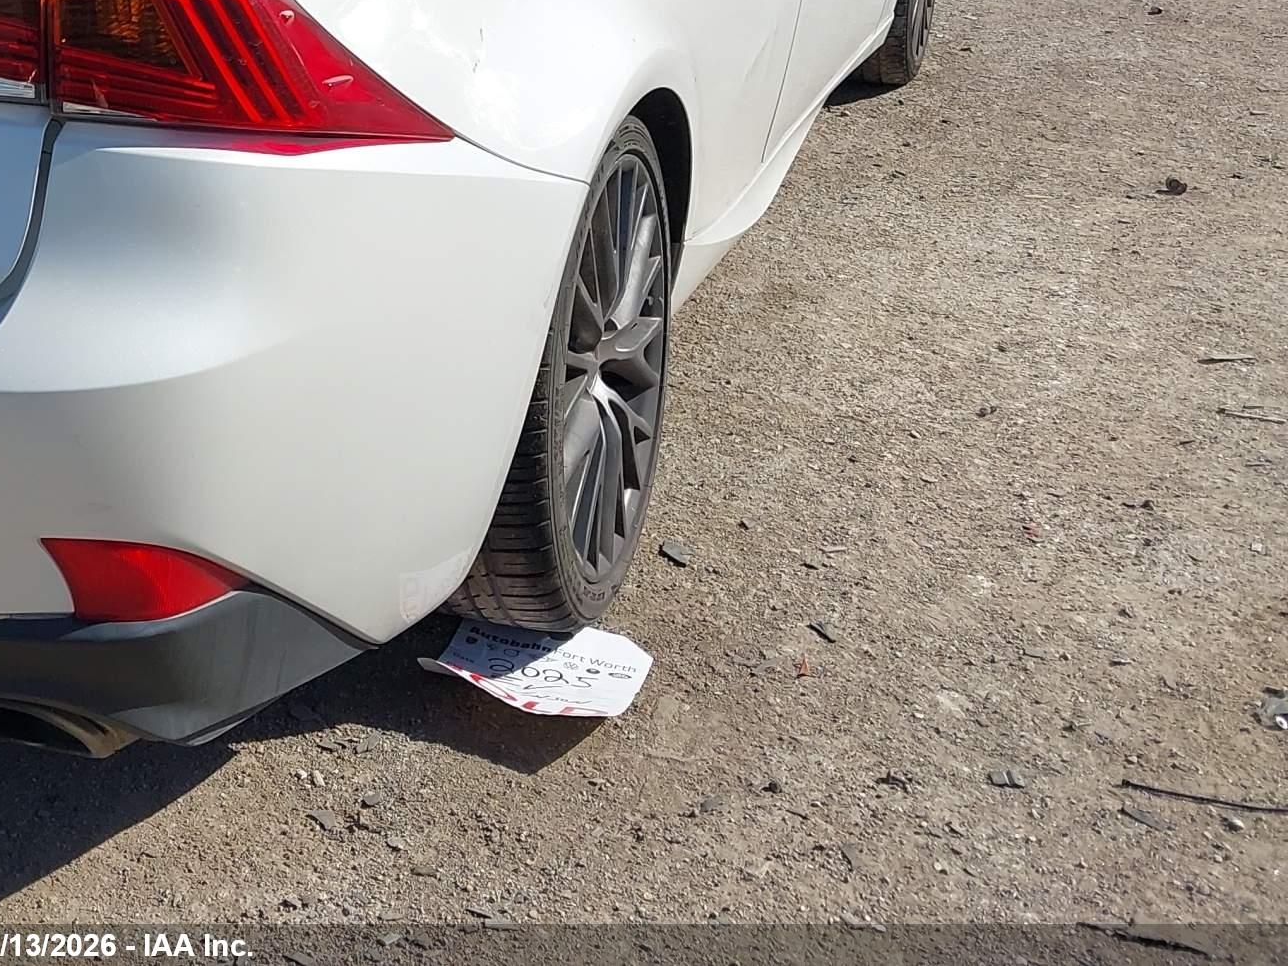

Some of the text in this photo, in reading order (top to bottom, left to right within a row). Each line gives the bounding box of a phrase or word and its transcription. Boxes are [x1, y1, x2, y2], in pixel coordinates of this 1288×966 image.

[469, 626, 637, 673] Autobahn Fort Worth
